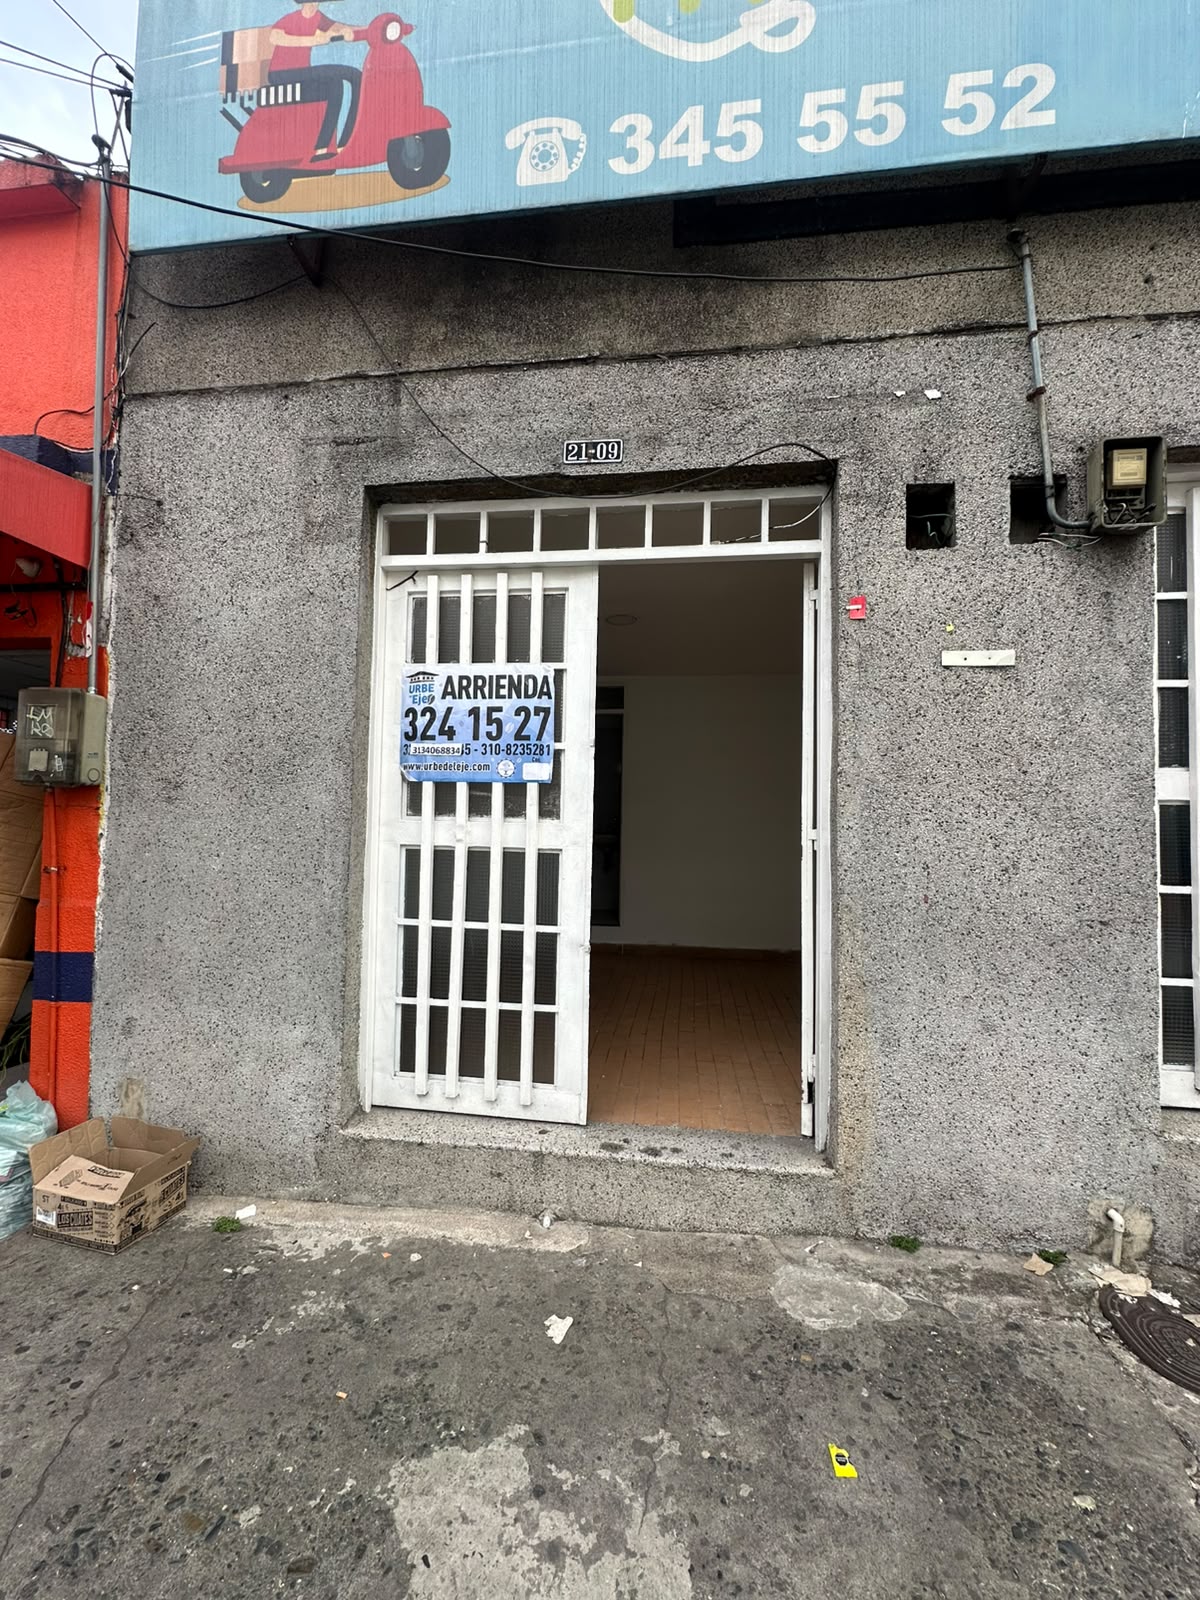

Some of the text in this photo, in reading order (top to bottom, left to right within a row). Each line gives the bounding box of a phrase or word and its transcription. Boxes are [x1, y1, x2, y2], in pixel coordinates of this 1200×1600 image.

[608, 63, 1057, 175] 345 55 52
[567, 442, 618, 460] 21-09
[409, 683, 435, 694] URBE
[440, 674, 553, 700] ARRIENDA
[412, 694, 428, 705] Eje
[403, 705, 551, 741] 324 15 27
[412, 746, 460, 755] 3134068834
[481, 743, 551, 756] 310-8235281
[403, 761, 490, 773] www.urbedeleje.com
